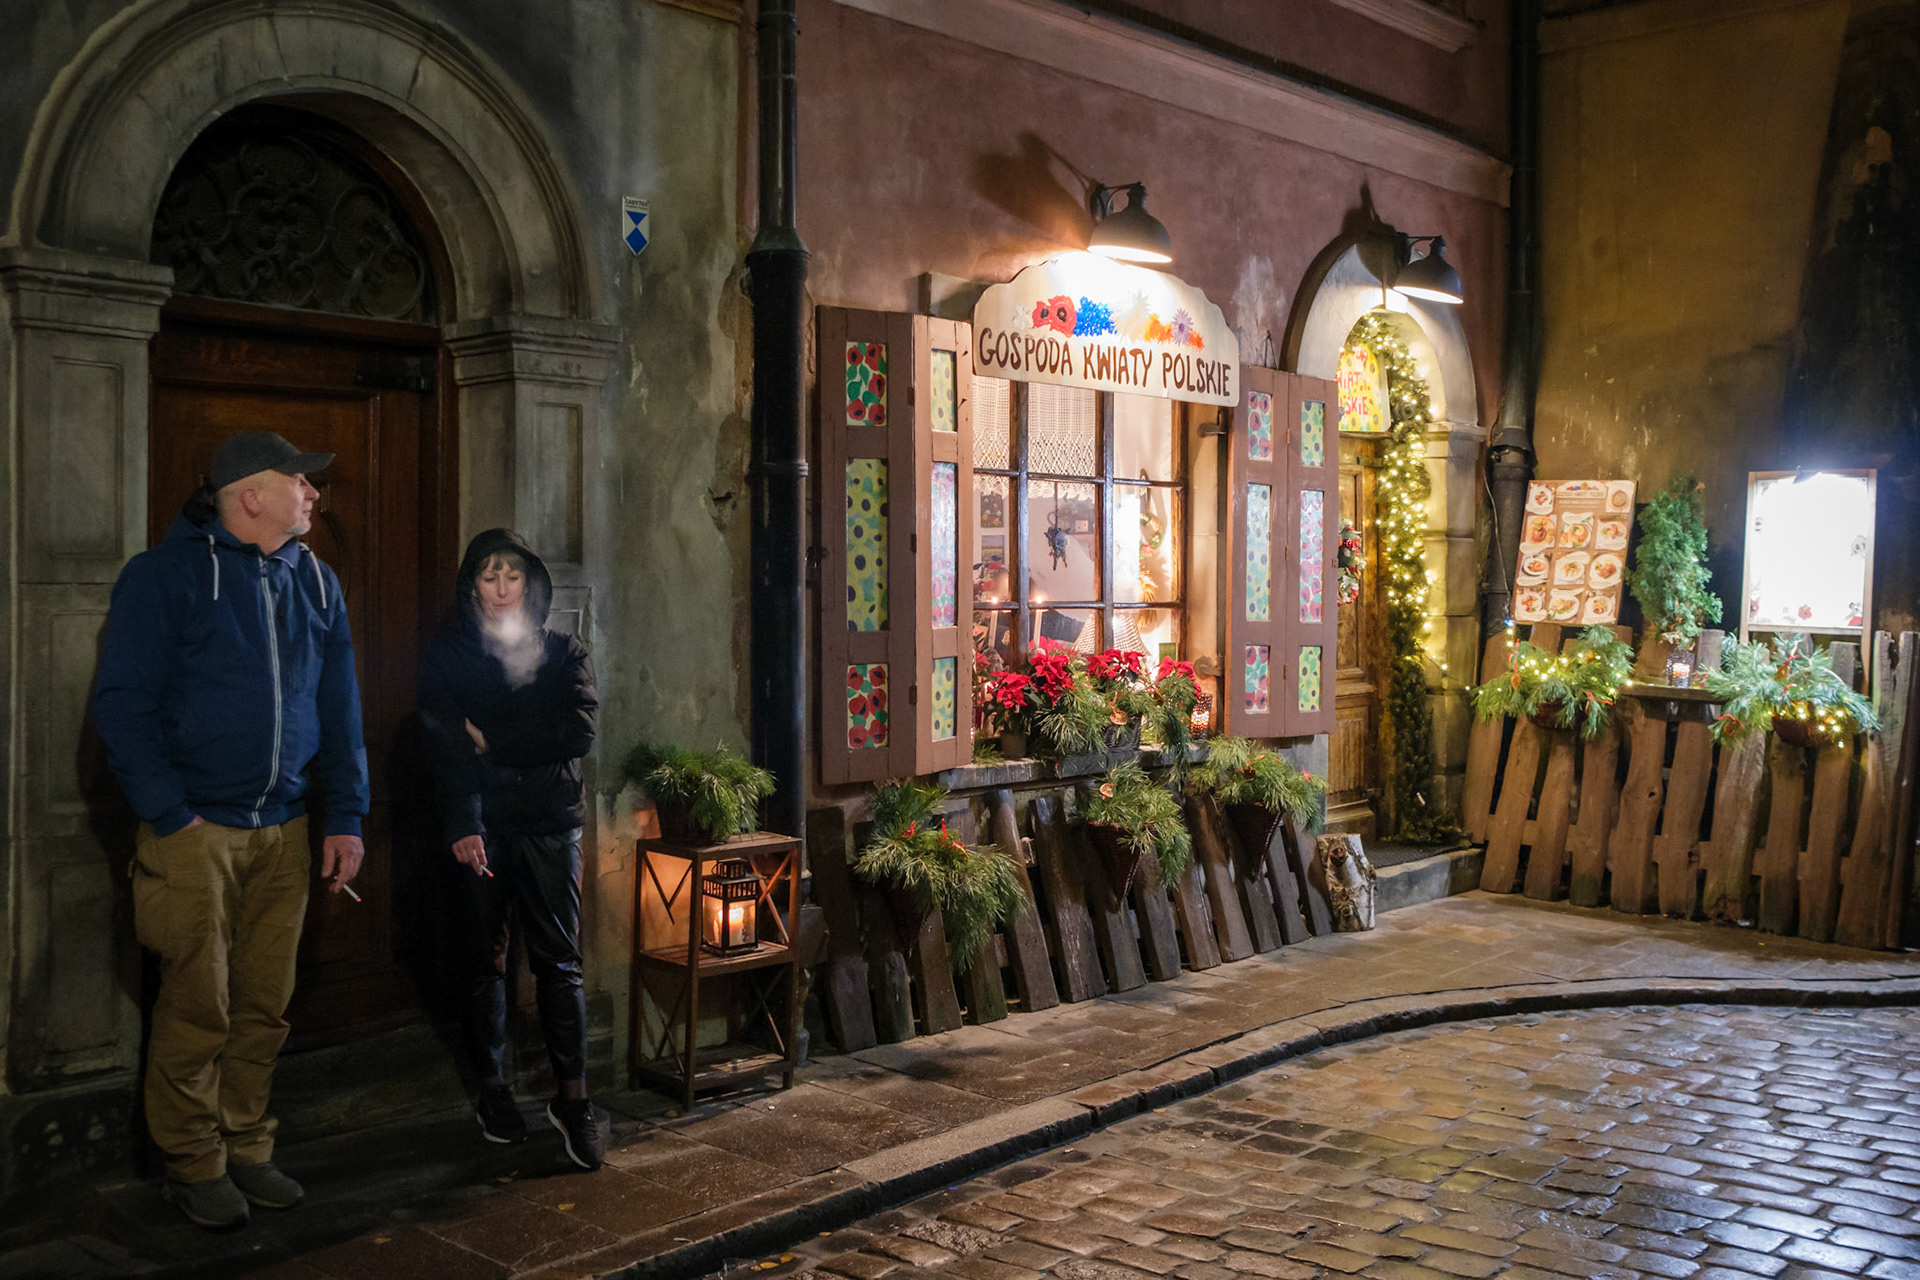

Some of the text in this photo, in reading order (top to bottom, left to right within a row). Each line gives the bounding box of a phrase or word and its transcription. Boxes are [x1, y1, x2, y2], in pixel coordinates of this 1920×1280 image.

[979, 327, 1231, 397] GOSPODA KWIATY POLSKIE
